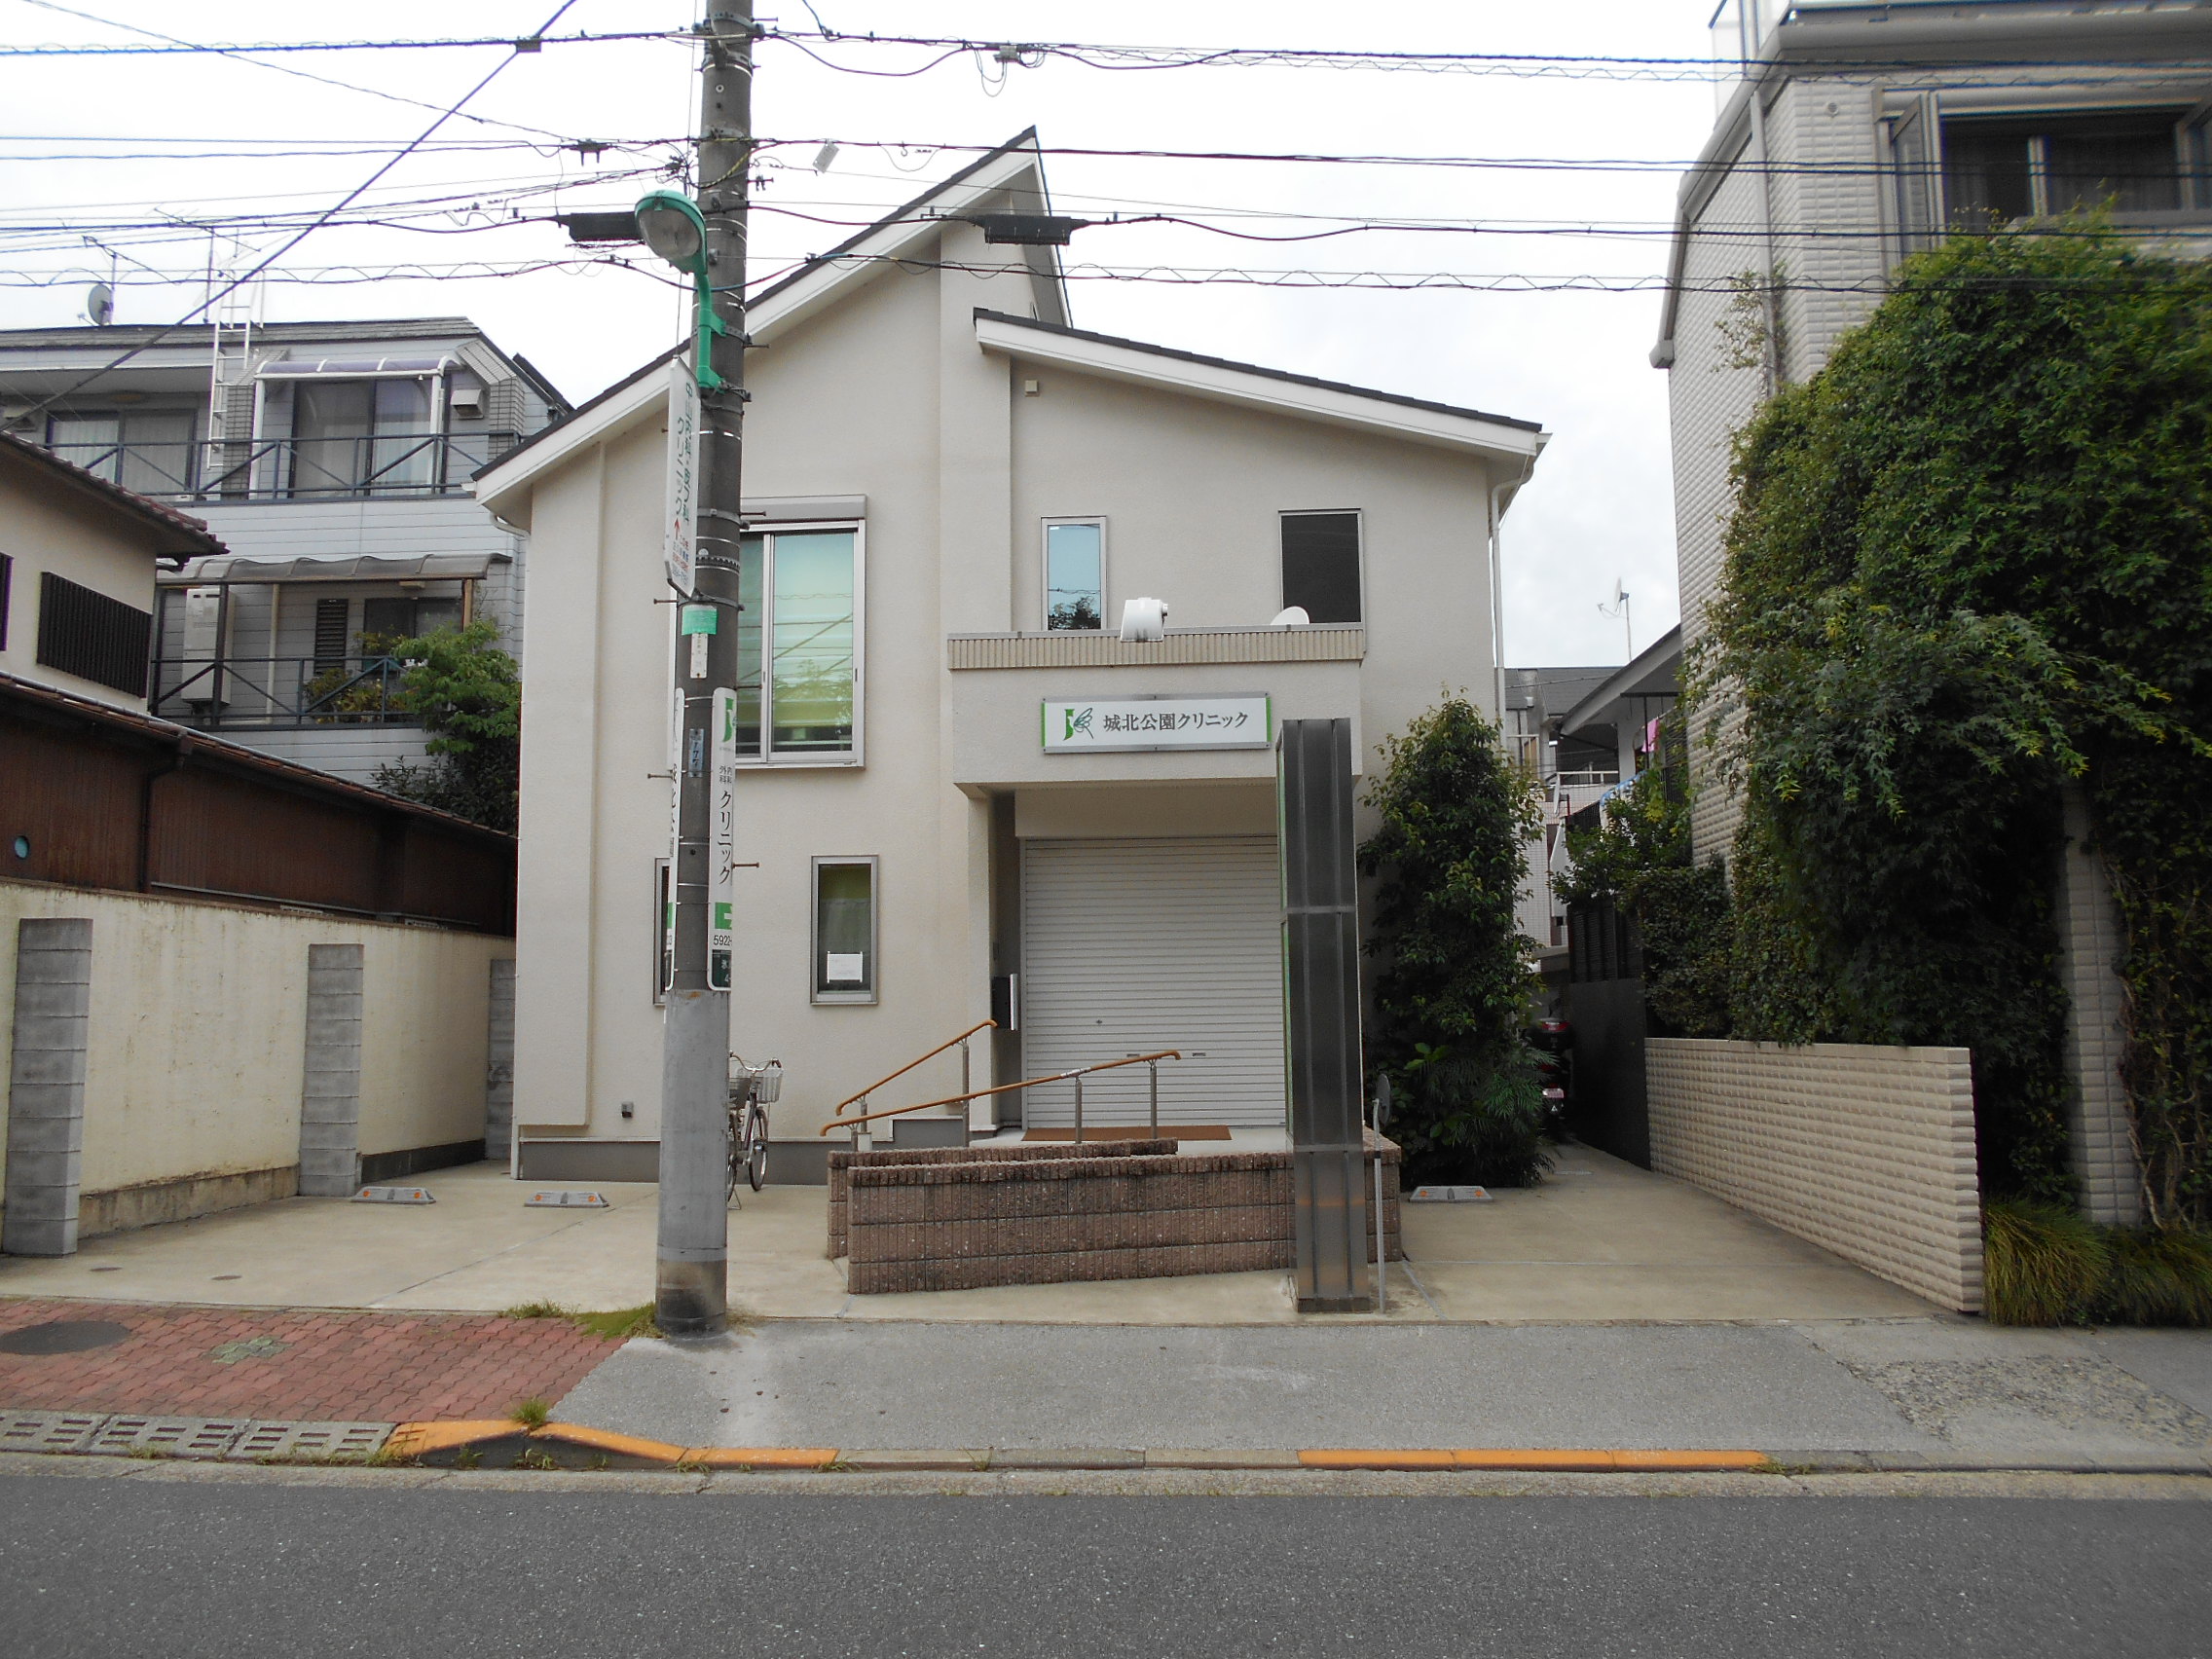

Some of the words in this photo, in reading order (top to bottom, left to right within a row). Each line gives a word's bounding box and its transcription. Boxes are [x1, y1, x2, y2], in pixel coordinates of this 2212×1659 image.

[675, 416, 685, 515] クリニック
[1103, 712, 1248, 732] 城北公園クリニック
[718, 790, 732, 885] クリニック
